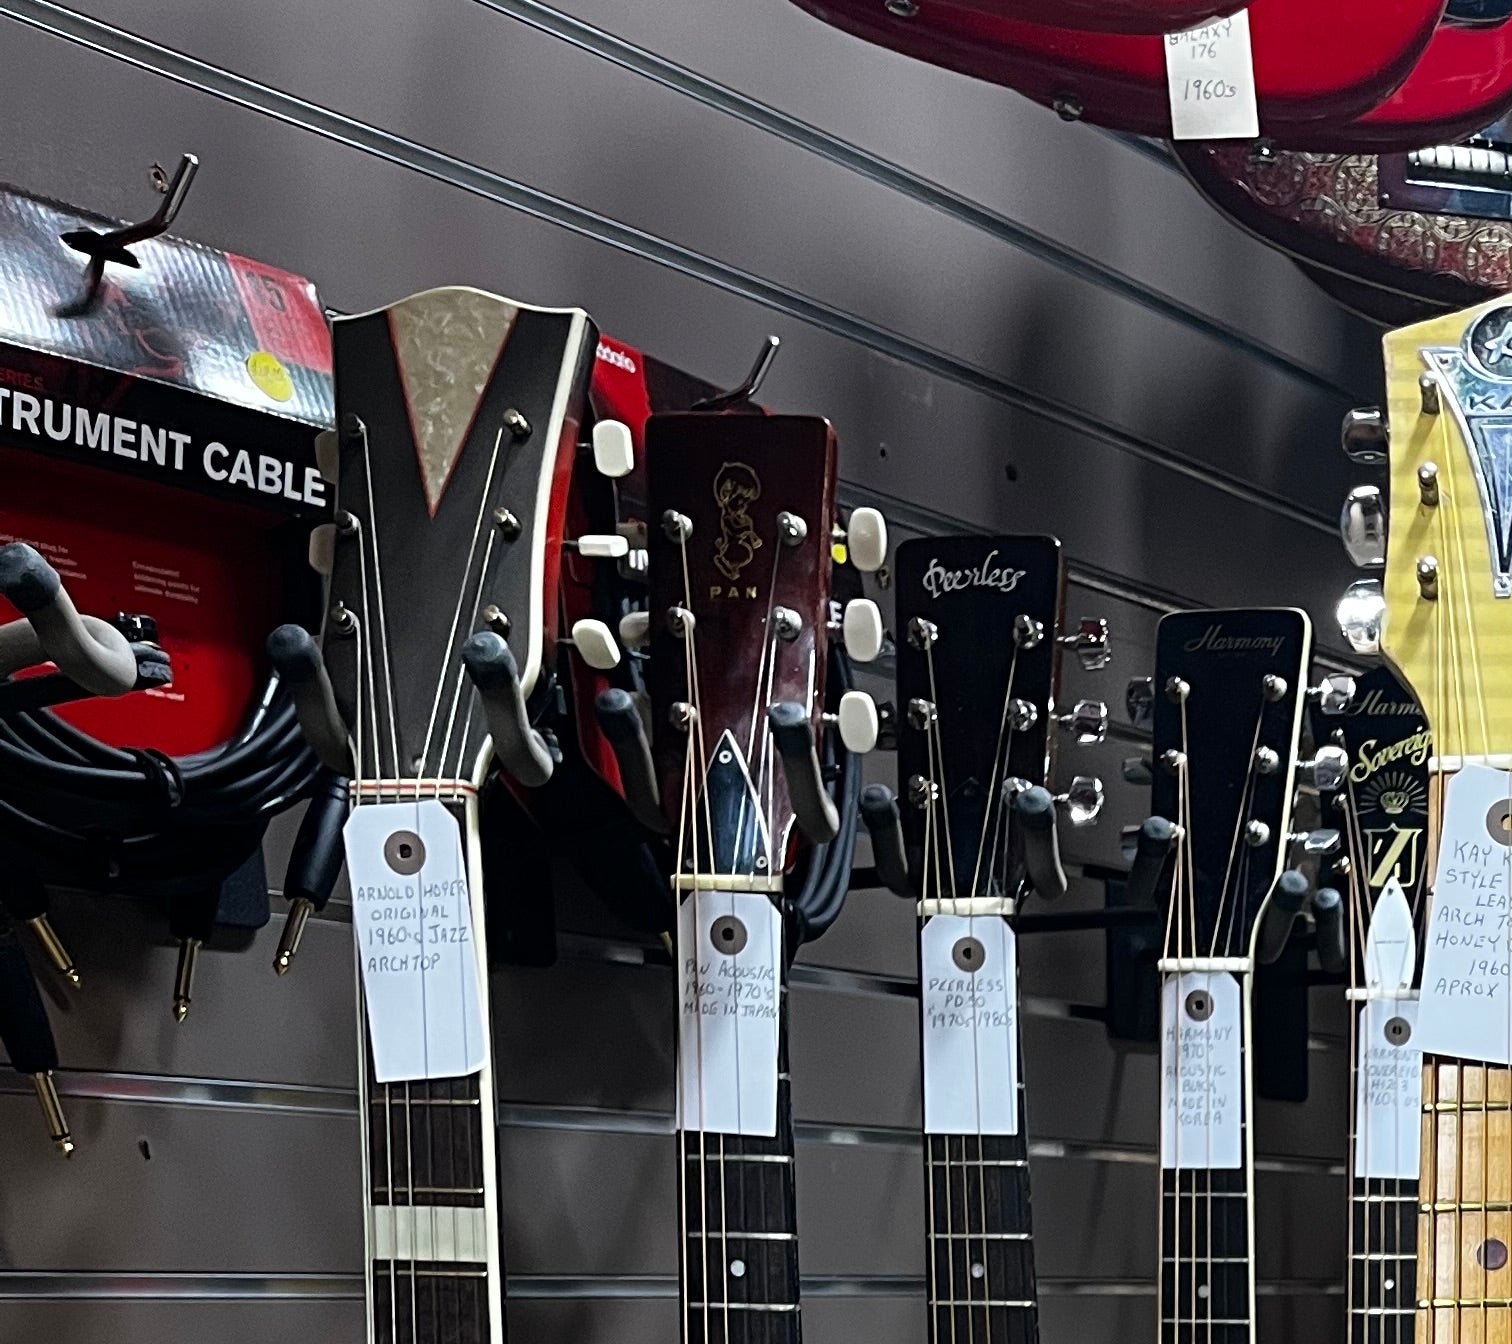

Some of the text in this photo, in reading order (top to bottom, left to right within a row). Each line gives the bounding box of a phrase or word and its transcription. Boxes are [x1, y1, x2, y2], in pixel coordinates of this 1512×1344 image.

[1191, 41, 1217, 59] 176
[203, 441, 327, 508] CABLE
[922, 549, 1027, 599] Peerless
[709, 586, 757, 599] PAN
[1184, 623, 1286, 657] Harmony
[1453, 840, 1493, 867] KAY
[357, 879, 468, 901] ARNOLD HOYER
[1445, 868, 1503, 891] STYLE
[371, 906, 449, 921] ORIGINAL
[1437, 905, 1485, 927] ARCH
[428, 924, 470, 945] JAZZ
[1435, 930, 1501, 953] HONEY
[367, 953, 441, 973] ARCHTOP
[928, 977, 1005, 993] PEERLESS
[1434, 977, 1500, 999] APROX
